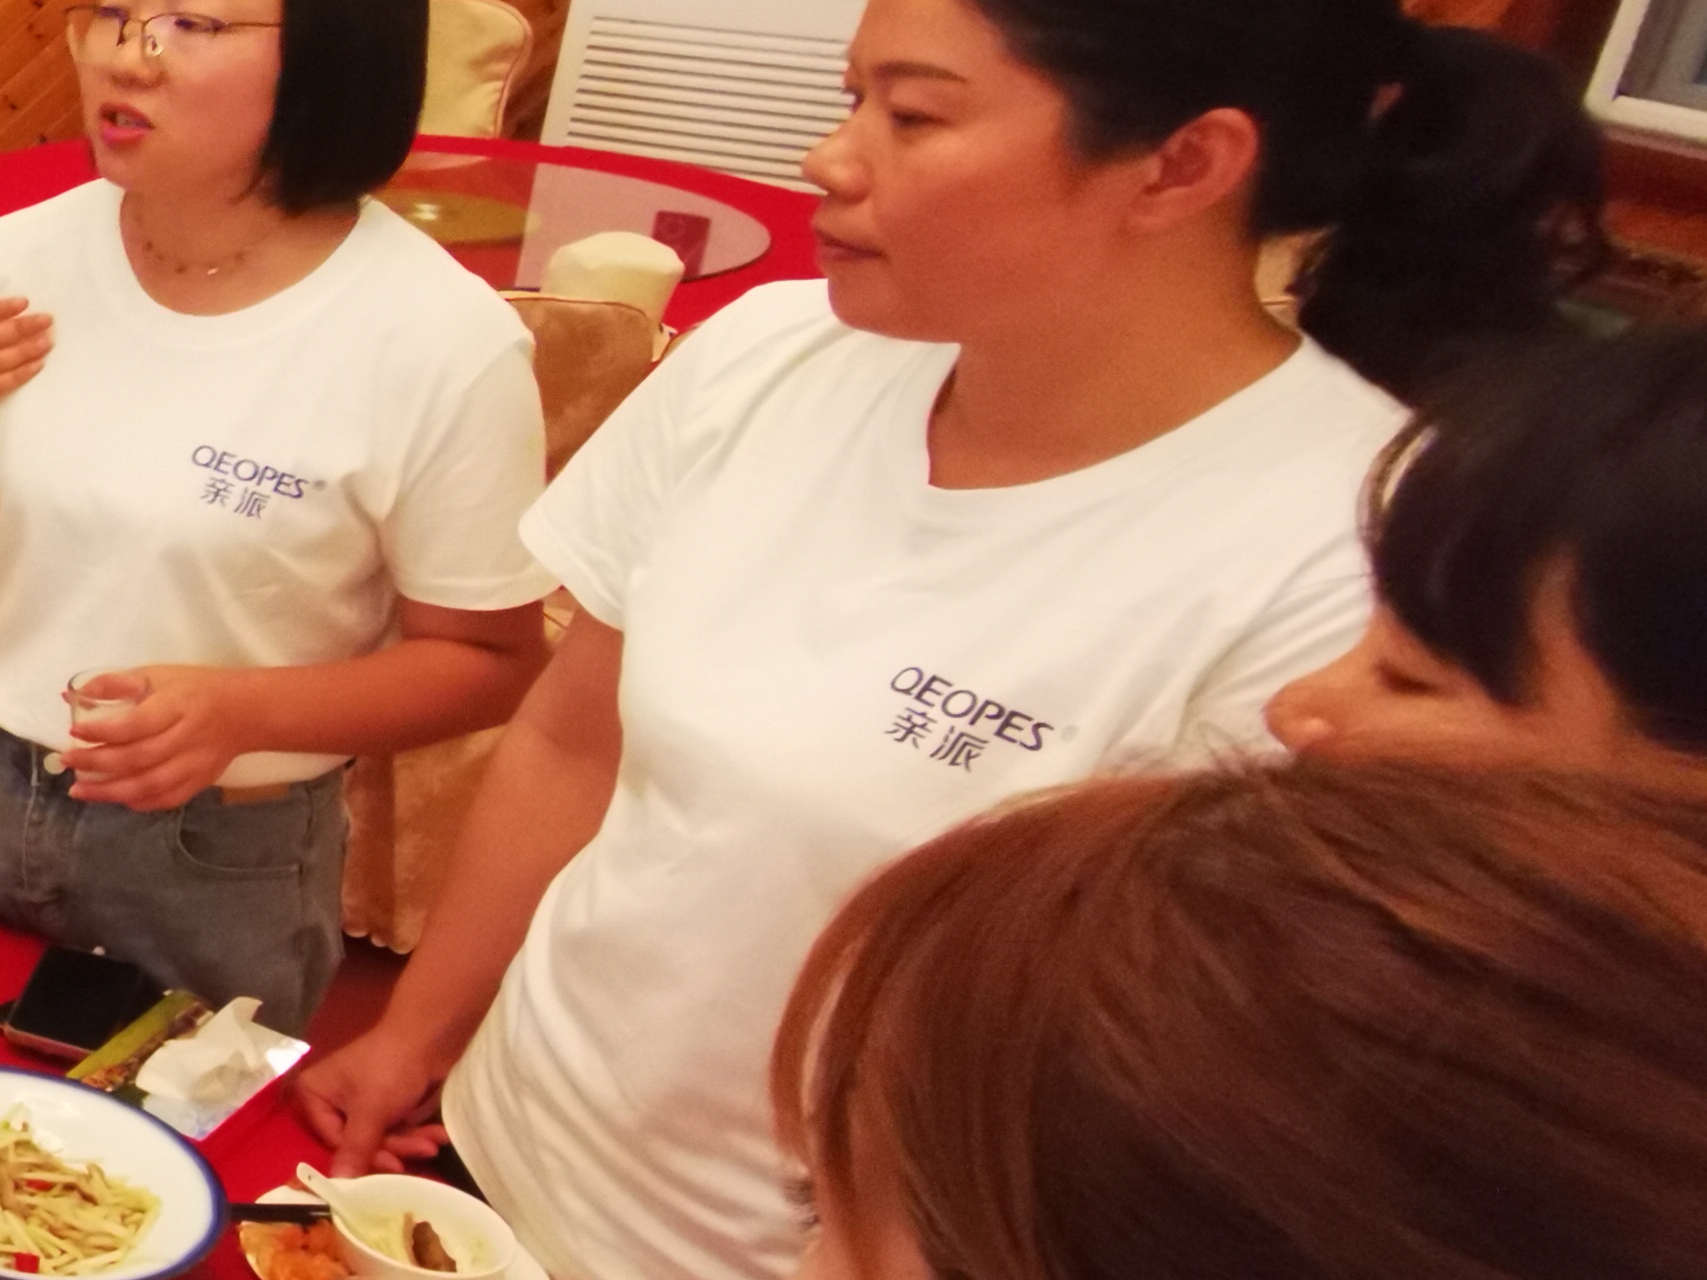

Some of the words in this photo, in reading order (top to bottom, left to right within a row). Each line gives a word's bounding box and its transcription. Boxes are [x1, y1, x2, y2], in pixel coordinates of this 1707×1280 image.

[190, 444, 310, 500] QEOPES
[199, 475, 271, 520] 亲派
[883, 706, 989, 773] 亲派
[889, 666, 1055, 752] QEOPES
